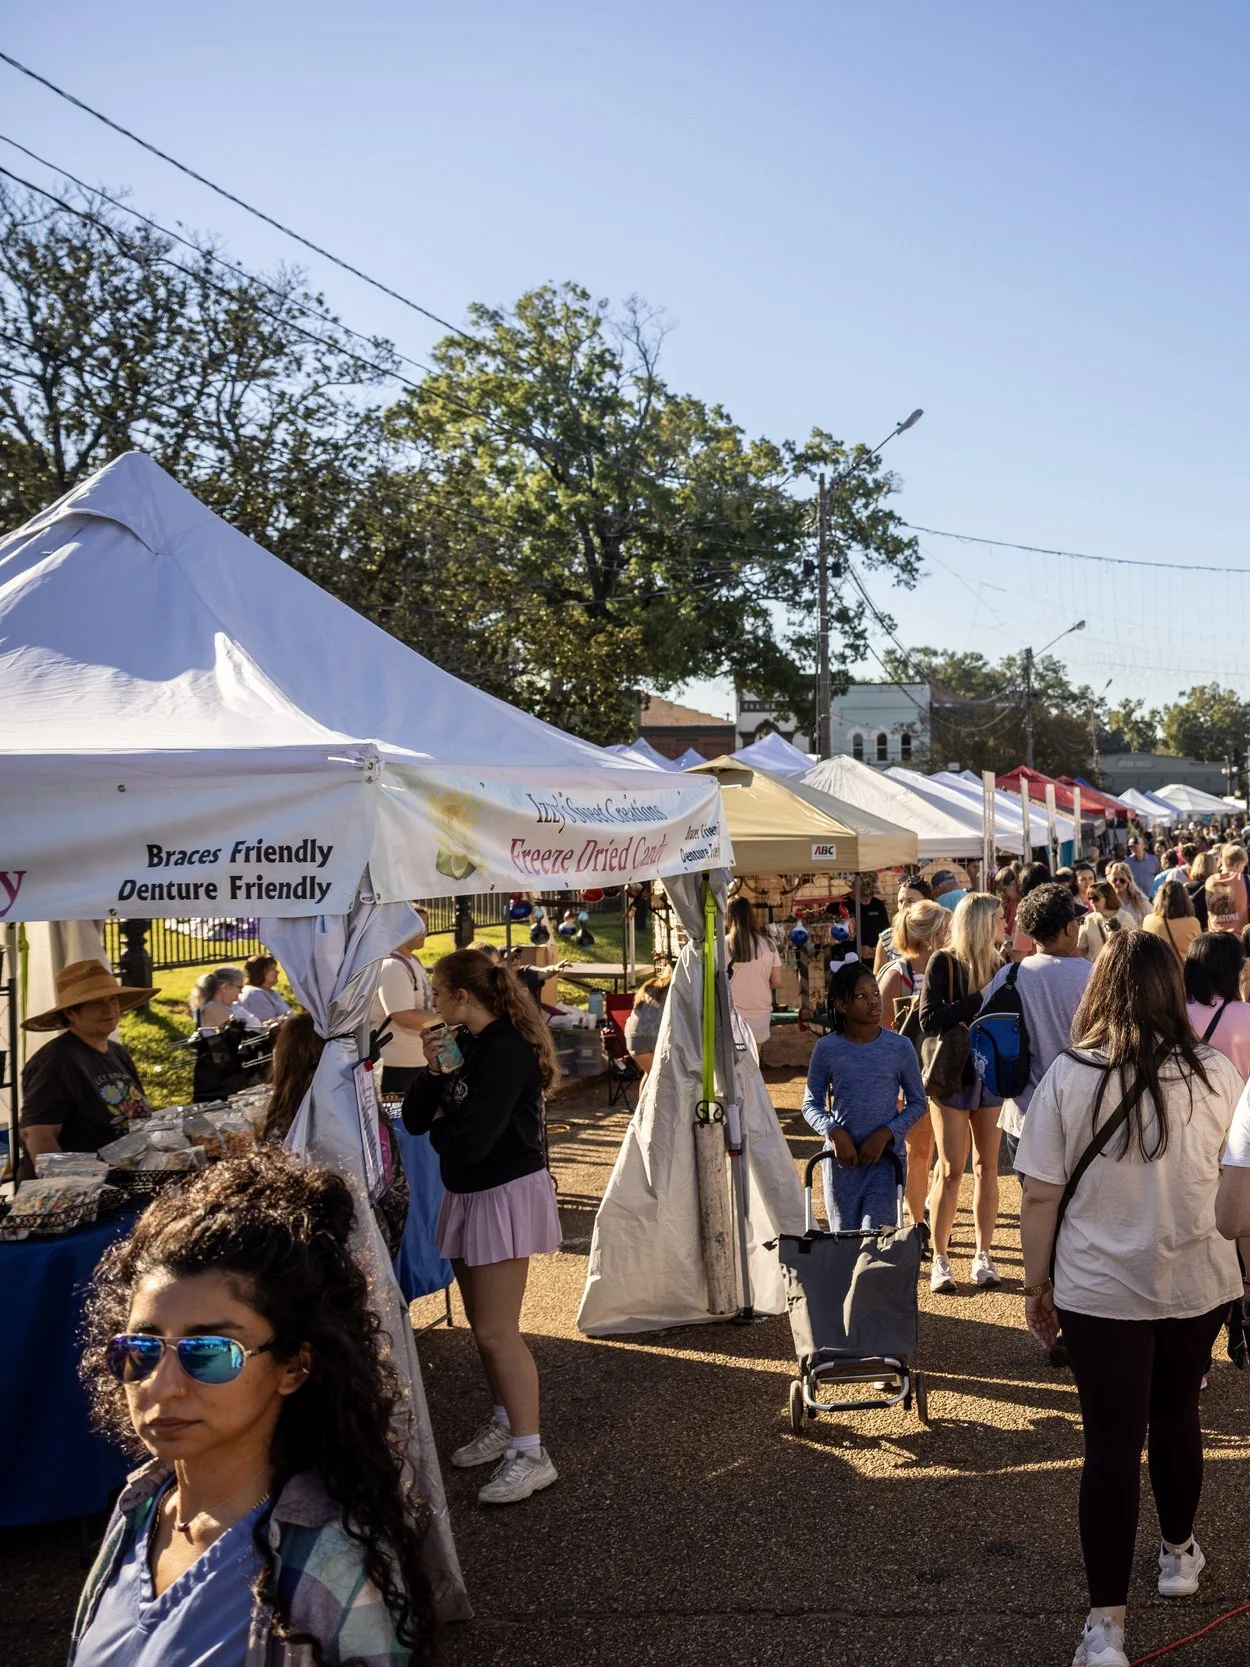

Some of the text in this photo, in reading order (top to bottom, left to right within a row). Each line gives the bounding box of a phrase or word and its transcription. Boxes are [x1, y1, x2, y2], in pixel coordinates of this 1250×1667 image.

[525, 793, 668, 834] Izzy's Sweet Creations
[146, 838, 334, 868] Braces Friendly
[511, 838, 575, 876] Freeze
[575, 836, 634, 873] Dried
[814, 845, 833, 855] ABC
[118, 874, 332, 905] Denture Friendly
